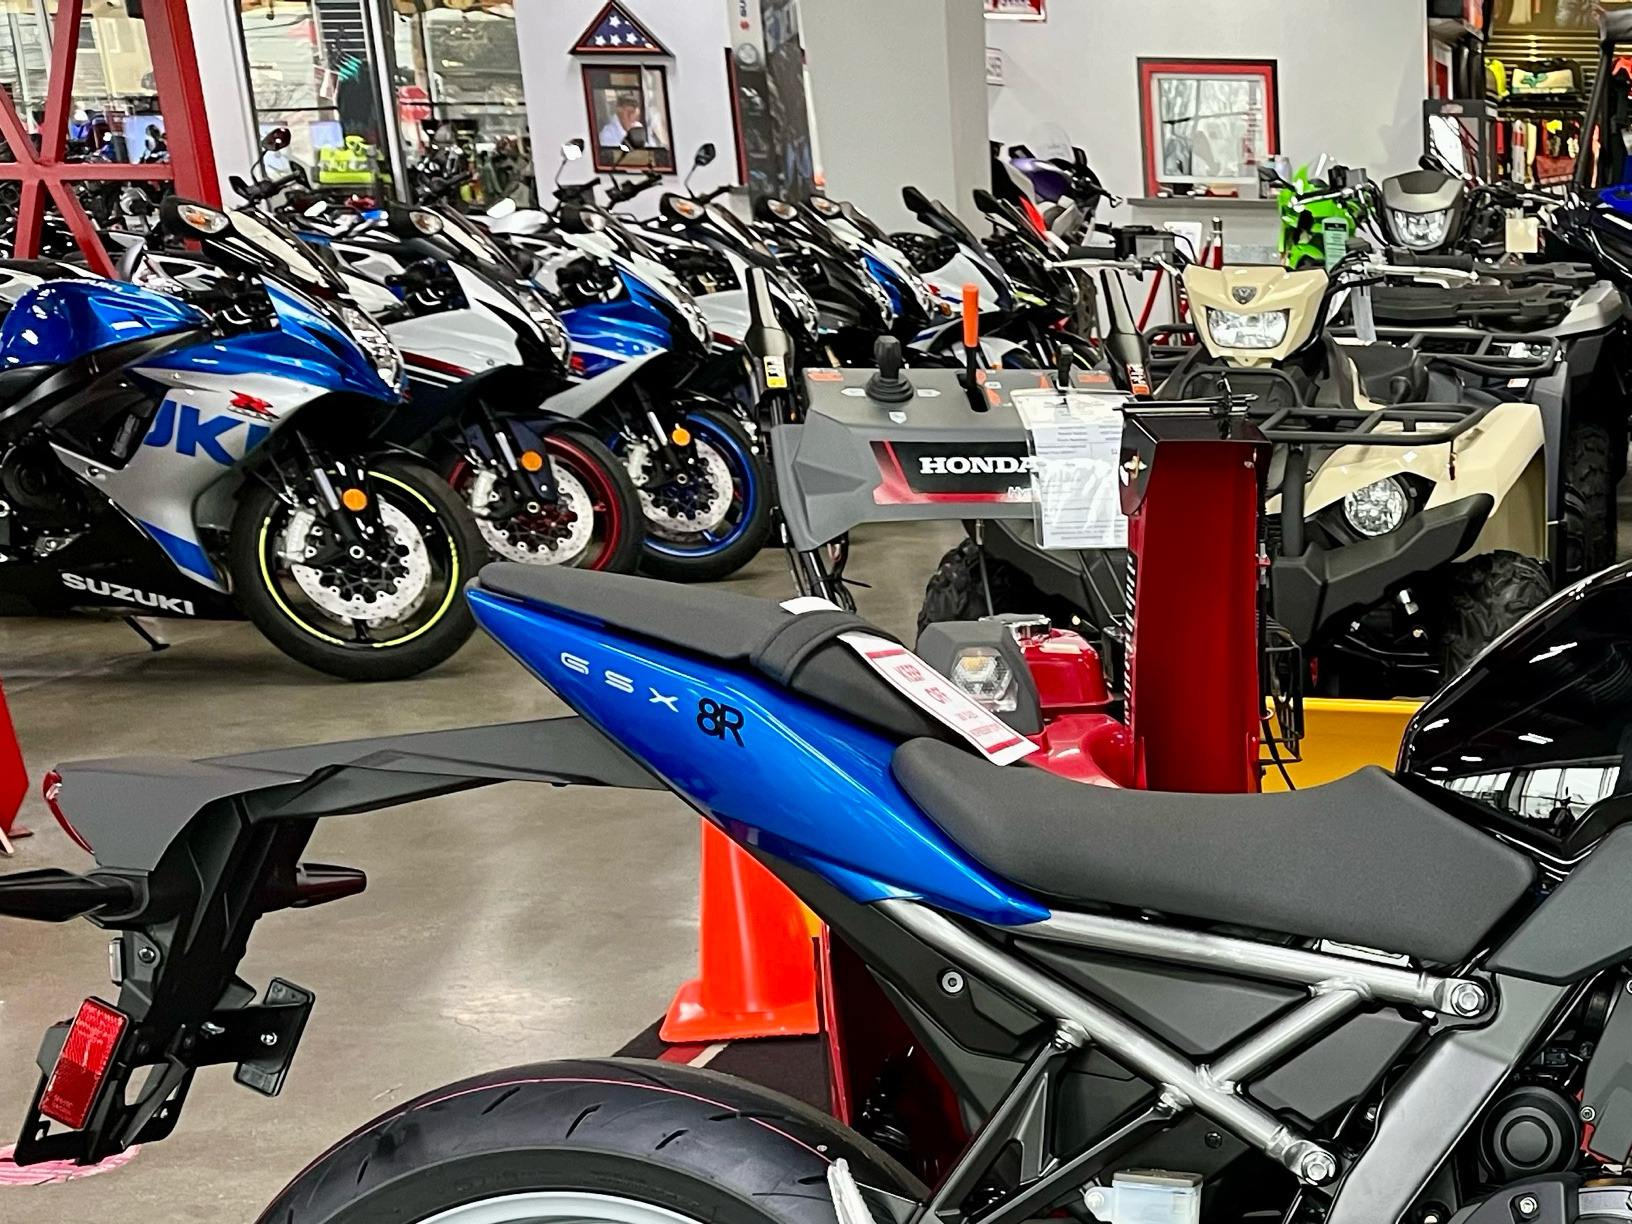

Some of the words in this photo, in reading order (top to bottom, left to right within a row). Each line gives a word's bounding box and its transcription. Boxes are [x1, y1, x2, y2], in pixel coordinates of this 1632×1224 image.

[918, 456, 1038, 474] HONDA
[61, 572, 195, 616] SUZUKI
[696, 697, 745, 748] 8R
